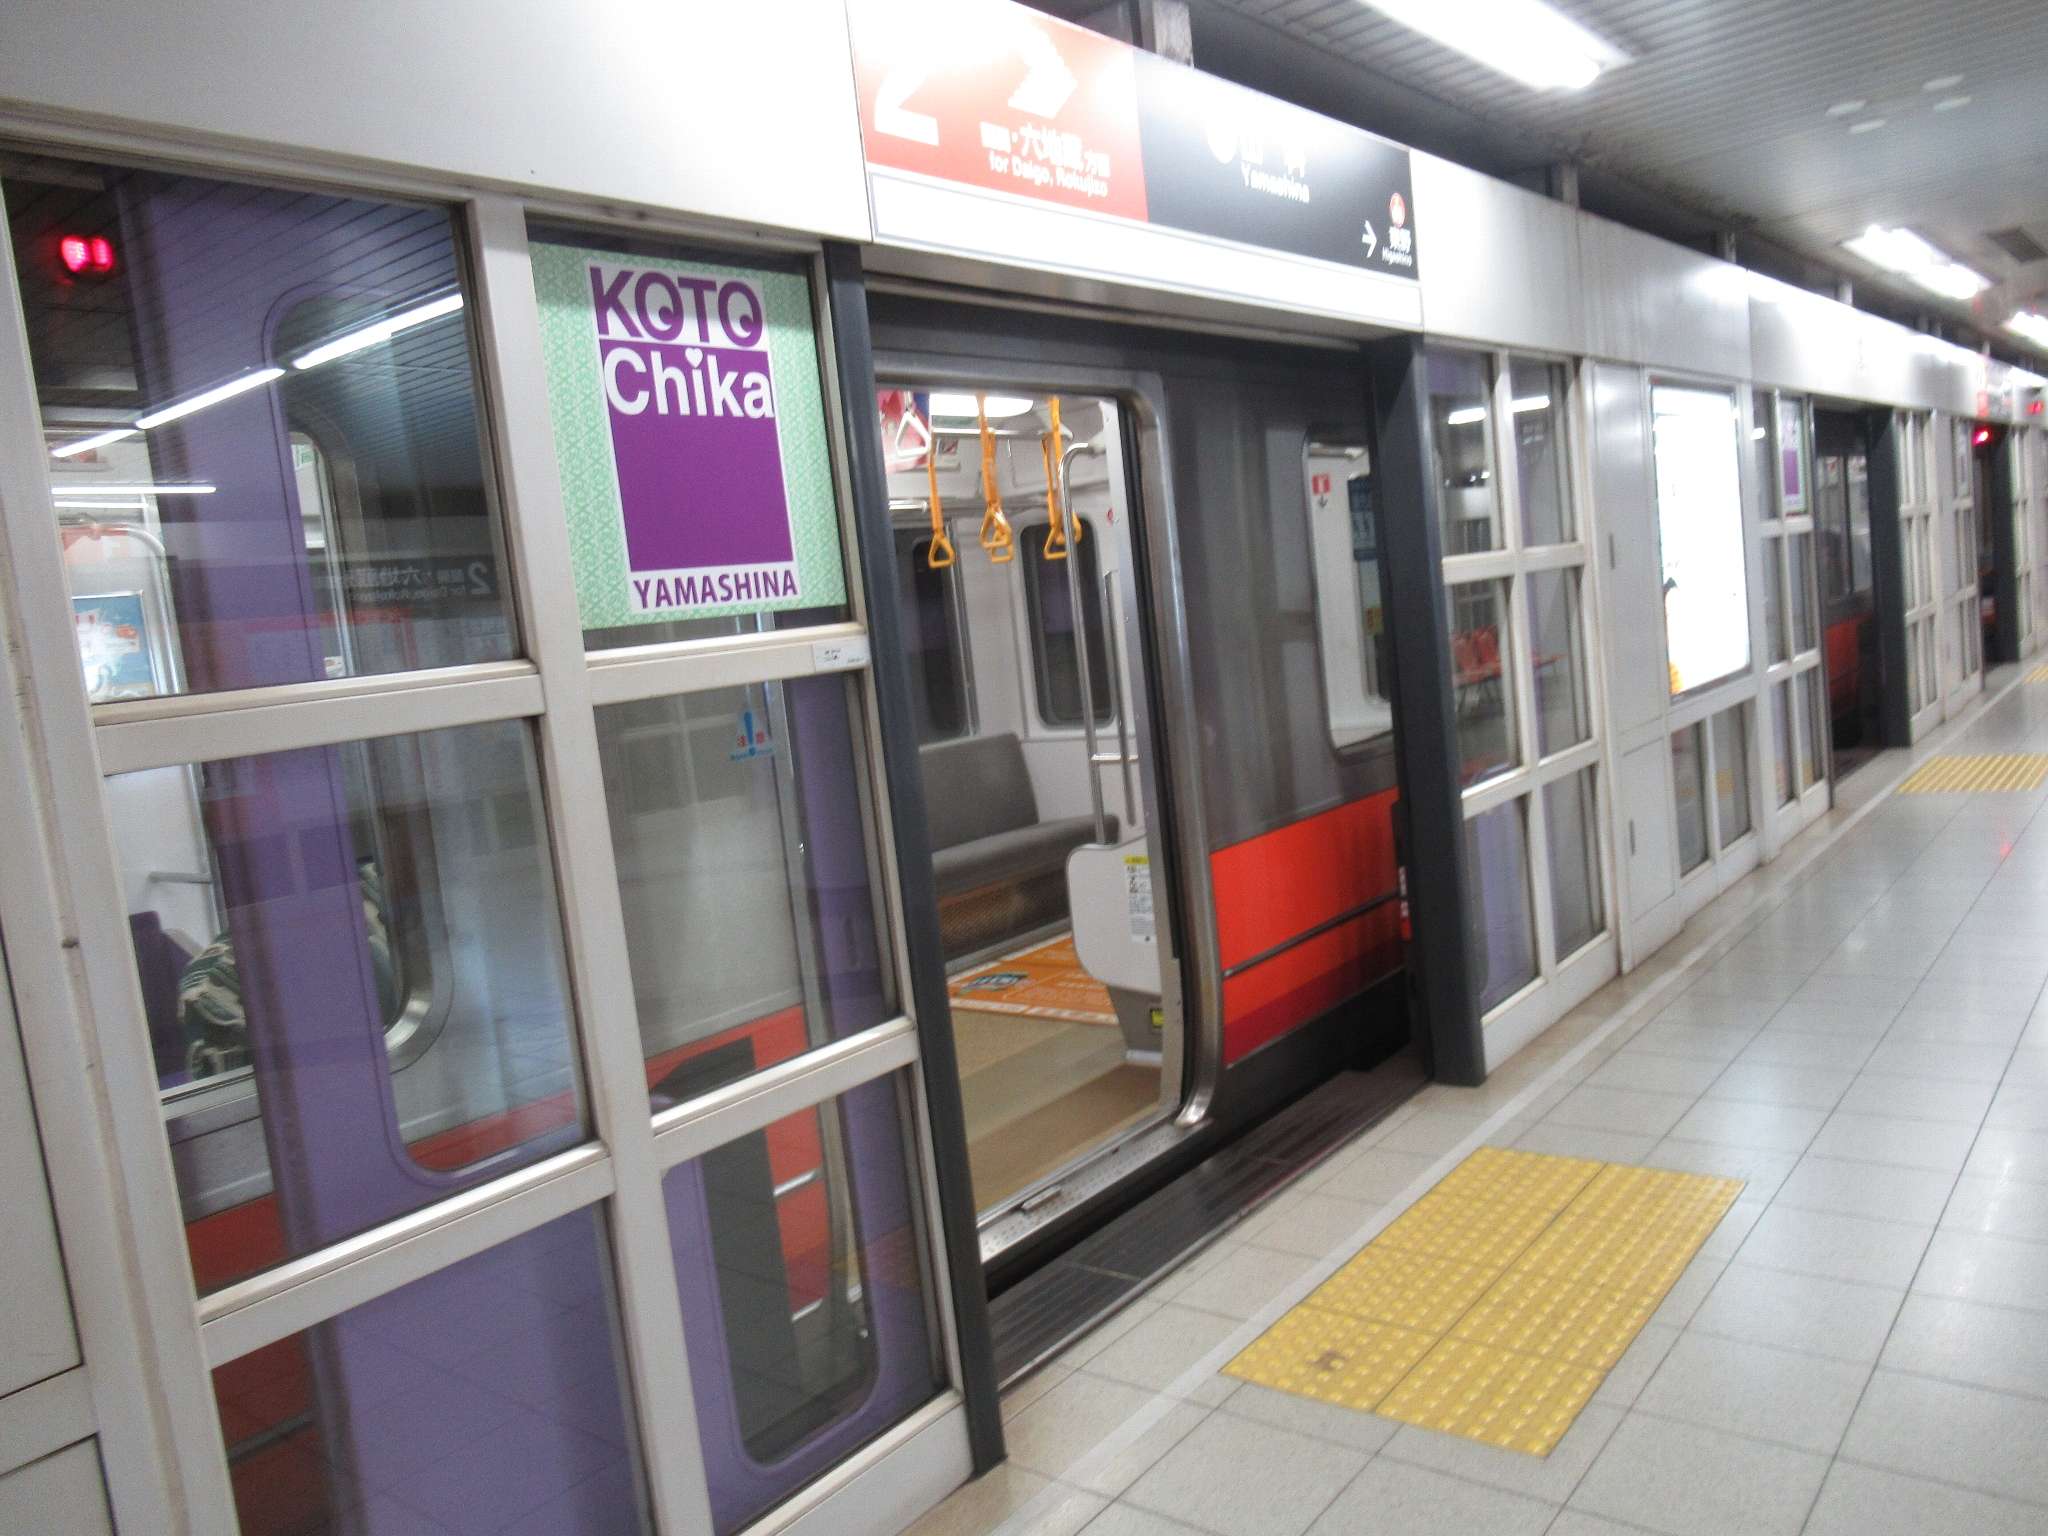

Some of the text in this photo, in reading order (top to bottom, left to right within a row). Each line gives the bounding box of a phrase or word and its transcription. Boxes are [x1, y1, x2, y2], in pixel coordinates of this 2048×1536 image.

[988, 149, 1009, 174] for
[590, 266, 764, 348] KOTO
[603, 346, 775, 419] Chika
[633, 569, 799, 609] YAMASHINA
